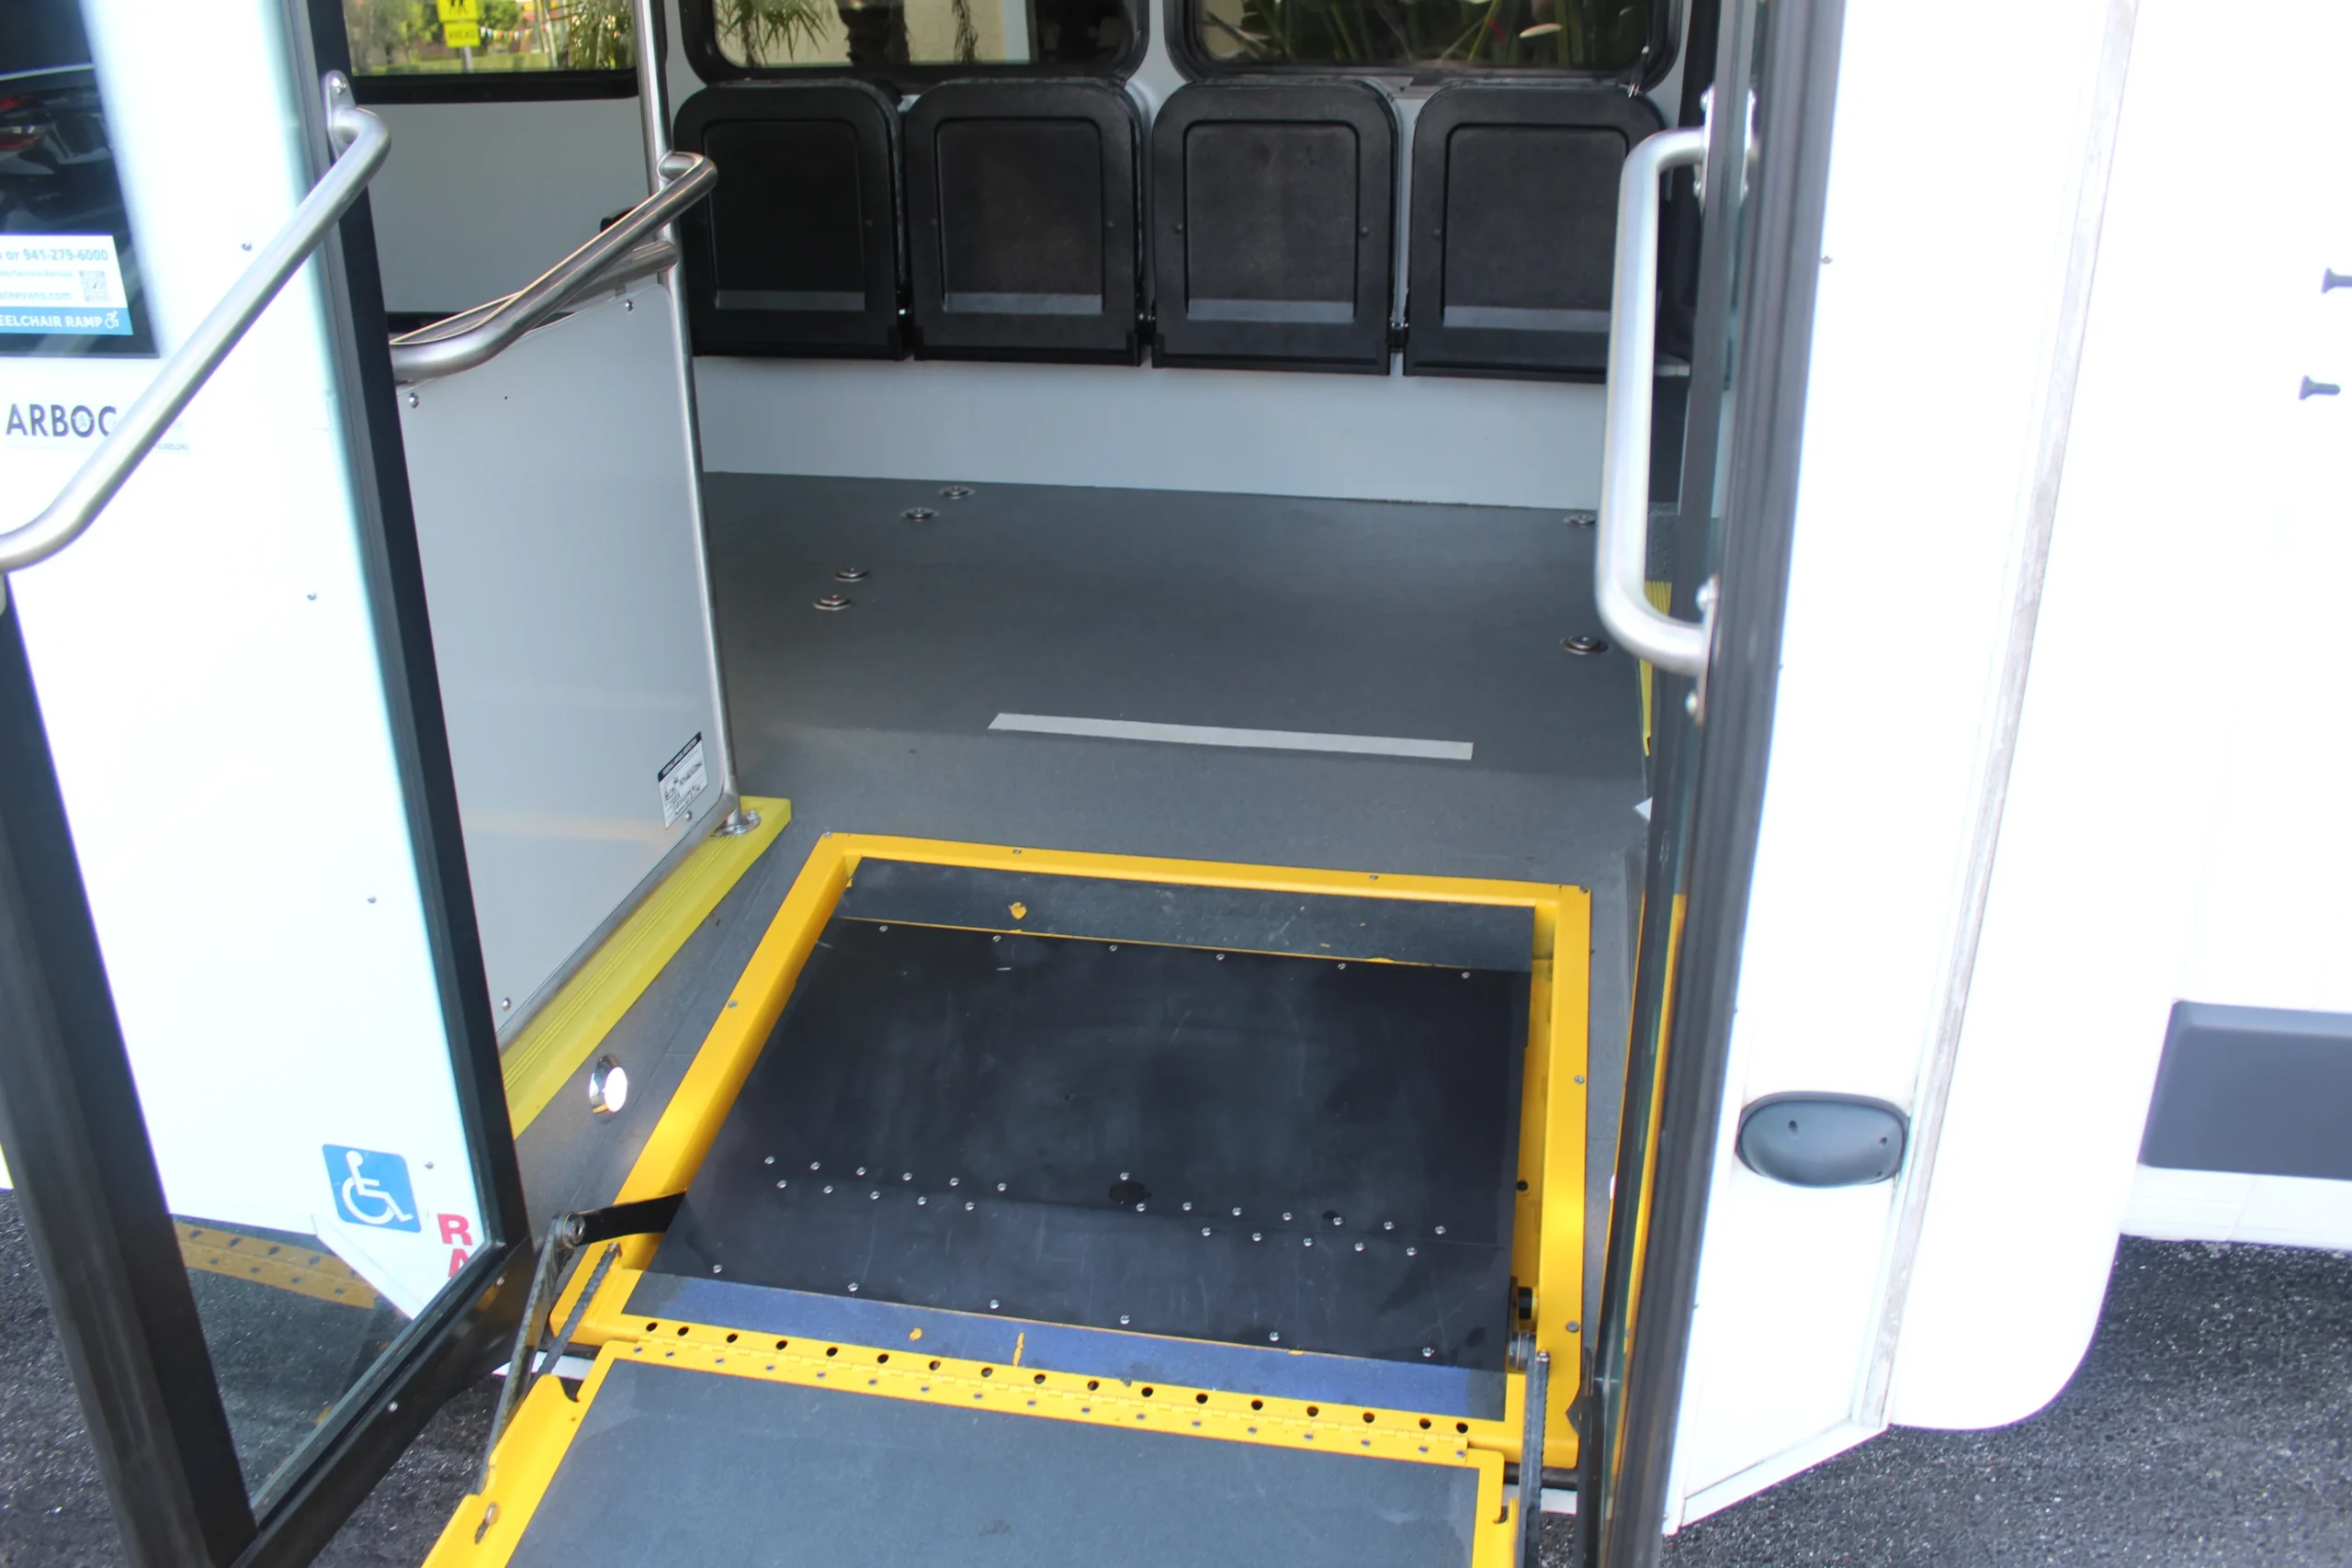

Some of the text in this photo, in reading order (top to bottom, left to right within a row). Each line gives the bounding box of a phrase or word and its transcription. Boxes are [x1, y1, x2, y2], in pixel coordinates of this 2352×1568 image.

[6, 251, 19, 261] or
[23, 248, 108, 261] 941-279-6000
[64, 315, 103, 328] RAMP
[6, 403, 118, 438] ARBOC
